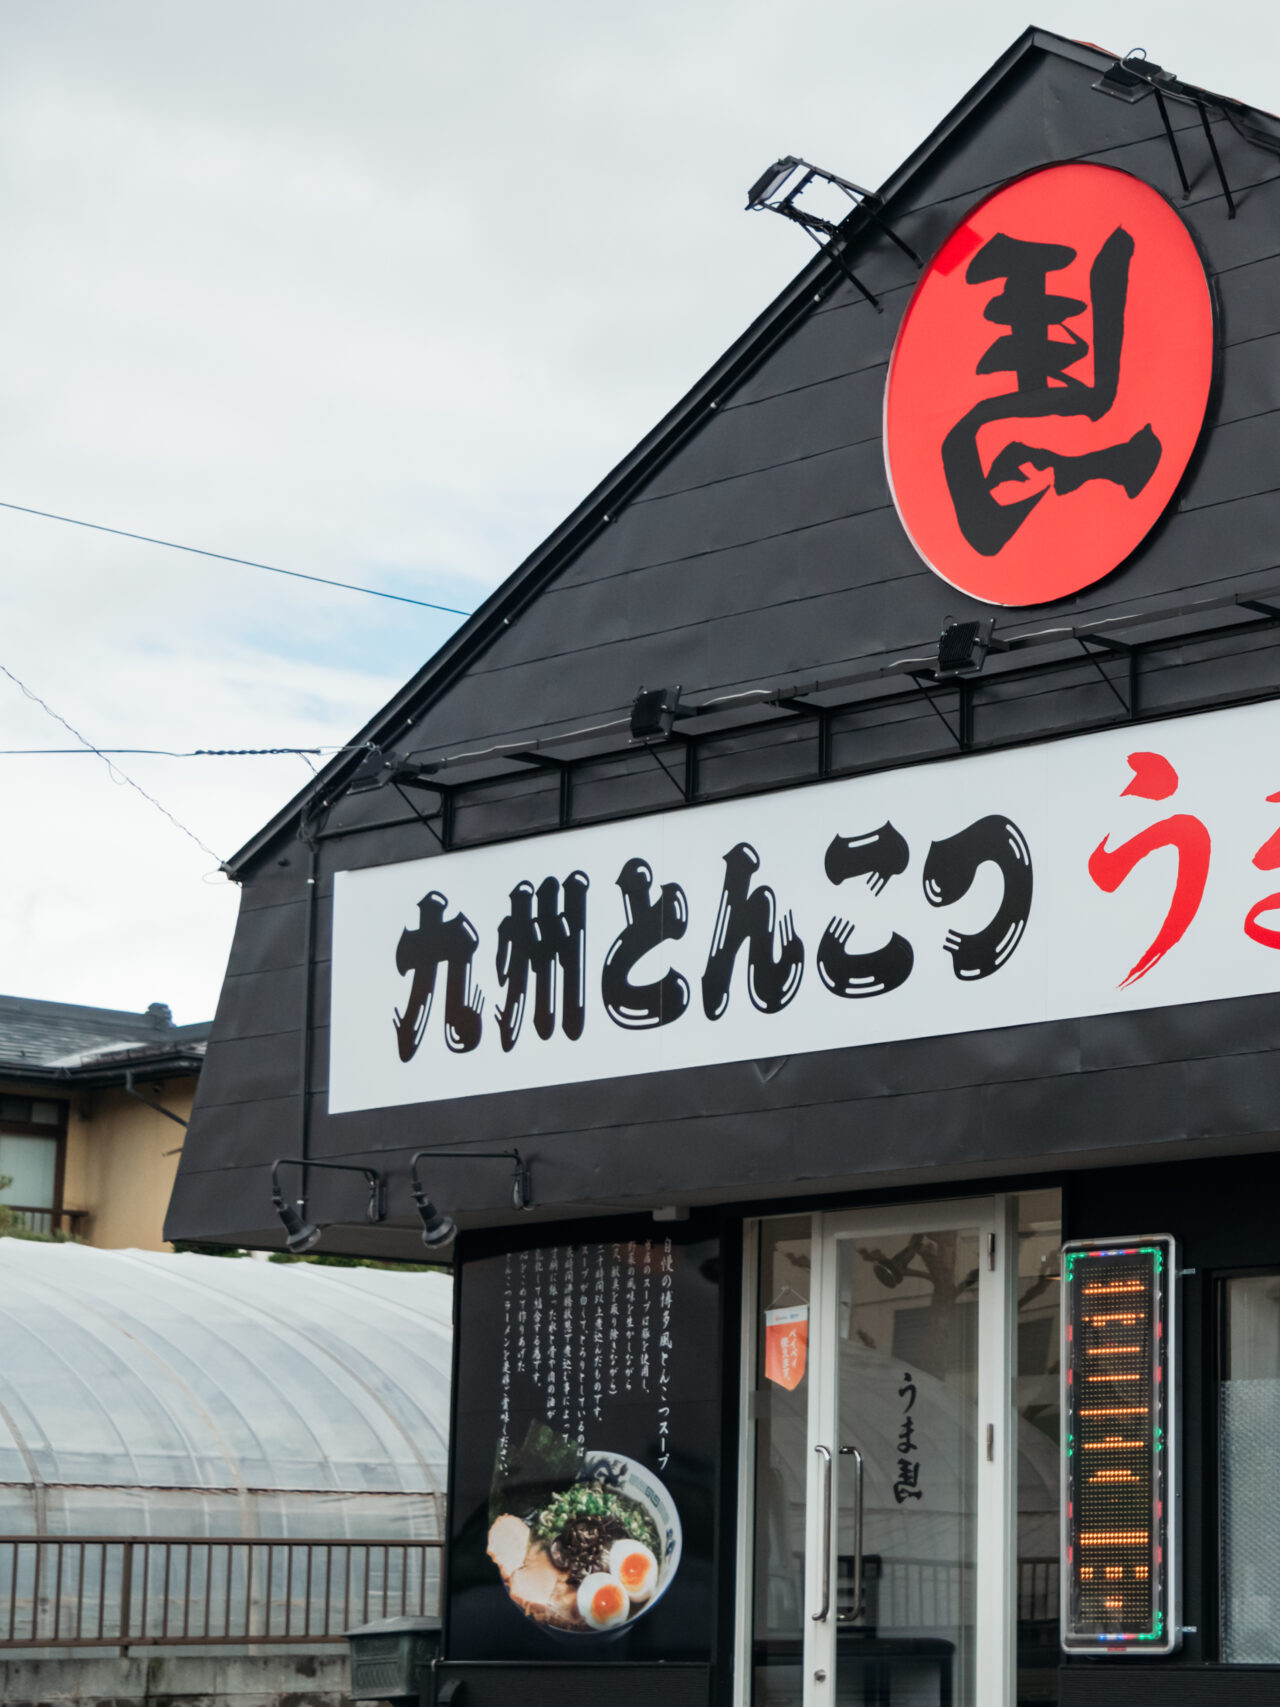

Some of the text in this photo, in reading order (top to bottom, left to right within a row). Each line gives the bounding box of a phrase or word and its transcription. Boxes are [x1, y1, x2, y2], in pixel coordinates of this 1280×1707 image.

[392, 814, 1034, 1063] 九州とんこつ
